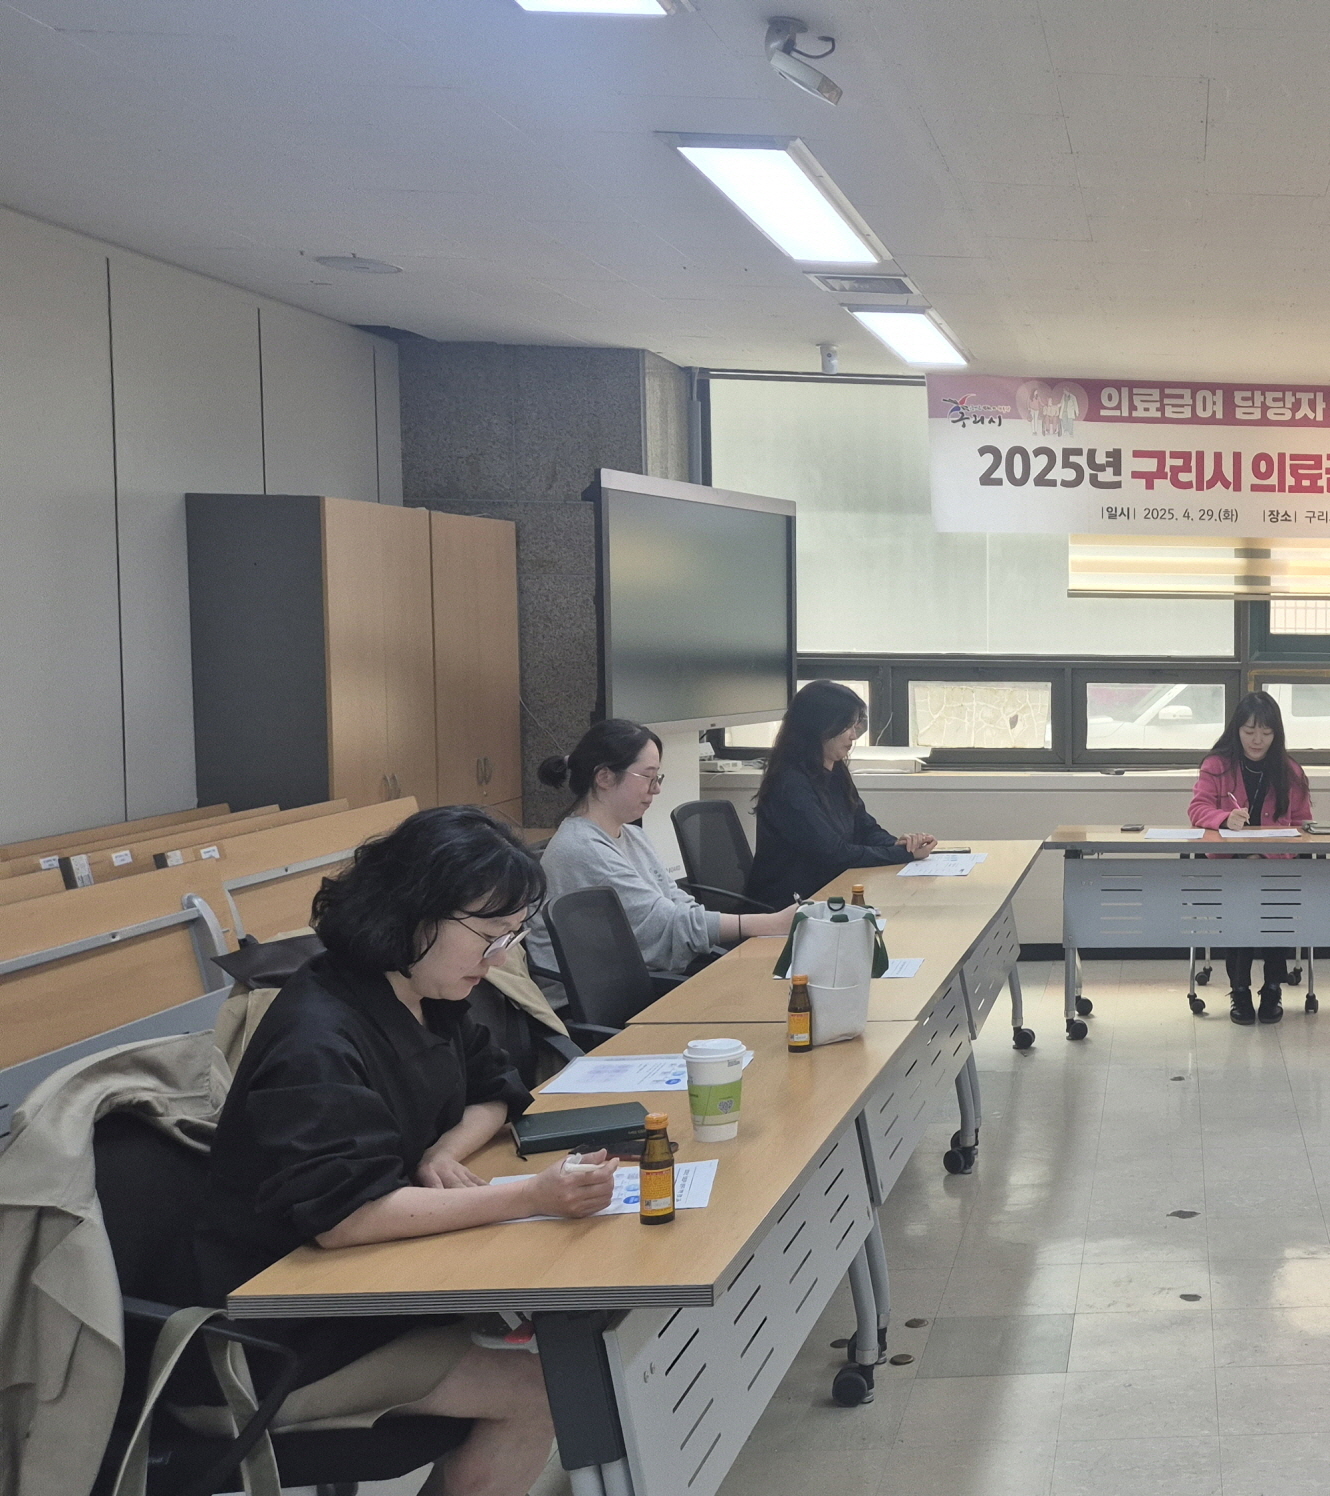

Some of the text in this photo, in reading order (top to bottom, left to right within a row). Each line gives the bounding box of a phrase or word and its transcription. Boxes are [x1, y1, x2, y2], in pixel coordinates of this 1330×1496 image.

[1100, 387, 1223, 419] 의료급여
[1234, 390, 1326, 421] 담당자
[951, 412, 1002, 428] 구리시
[977, 445, 1122, 489] 2025년
[1131, 450, 1242, 492] 구리시
[1143, 507, 1178, 521] 2025.
[1182, 508, 1194, 521] 4.
